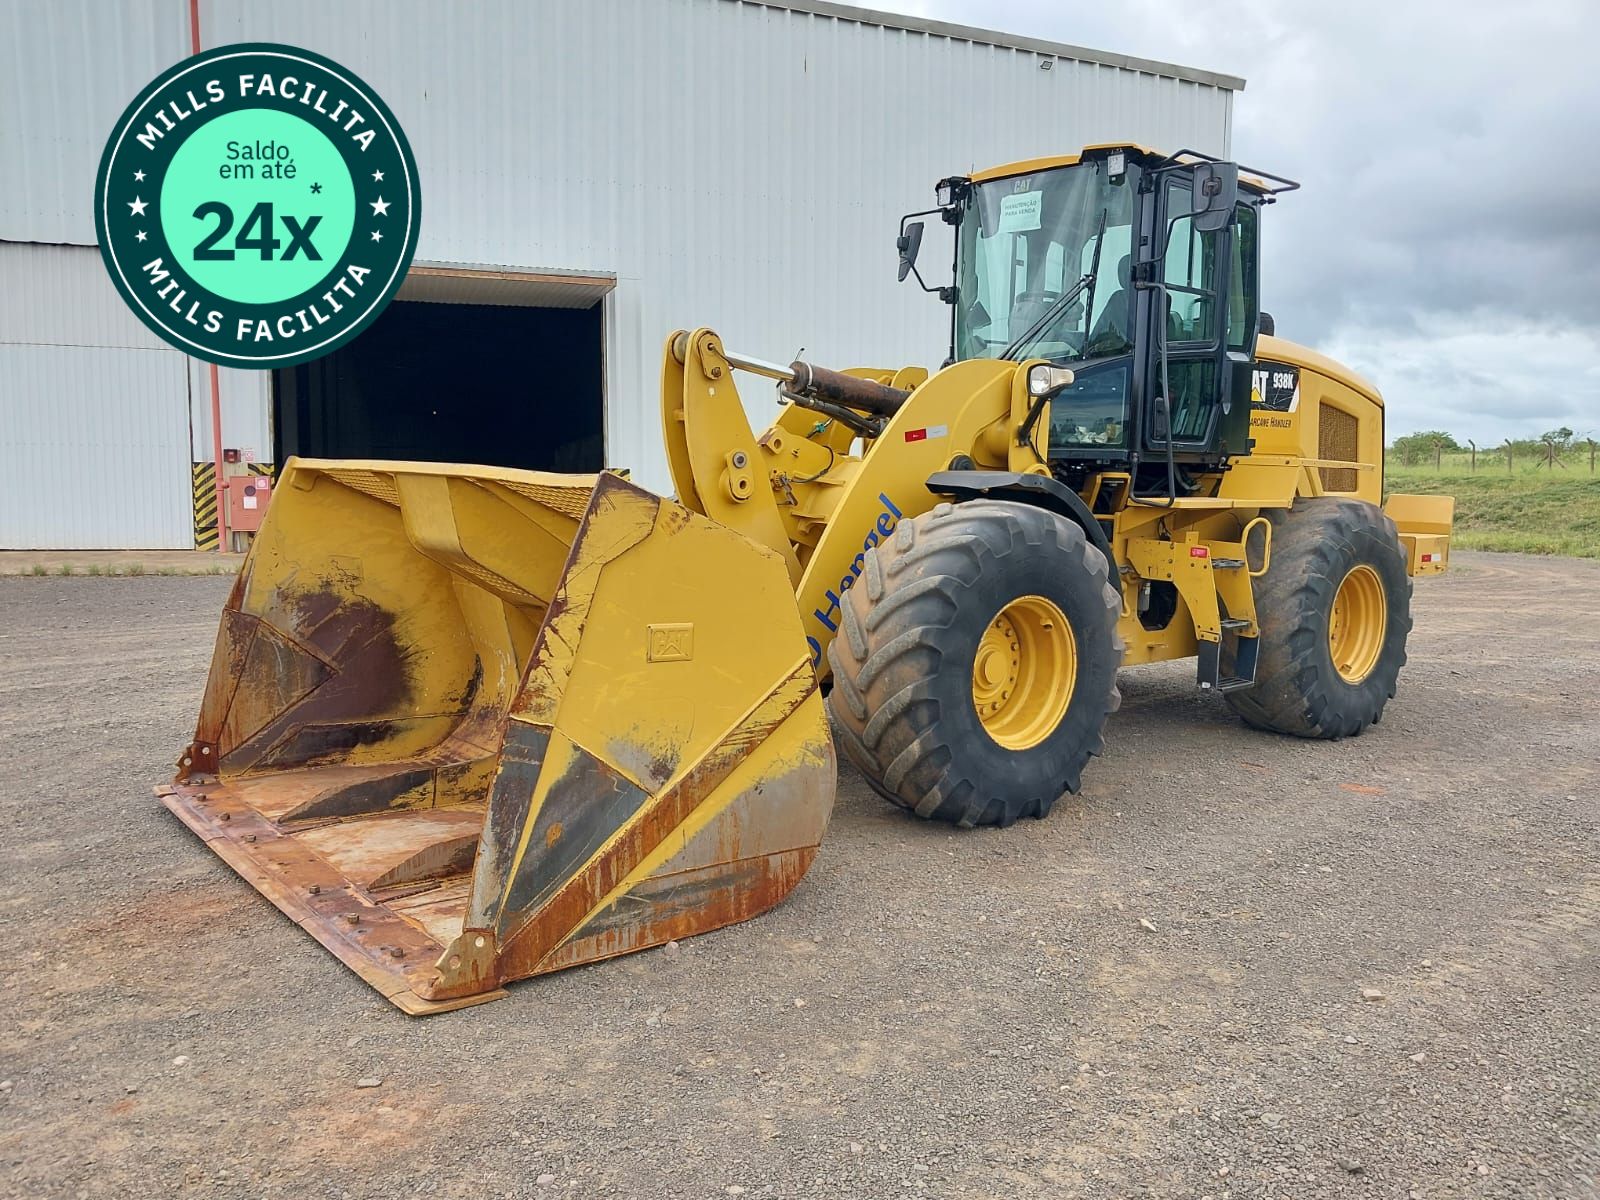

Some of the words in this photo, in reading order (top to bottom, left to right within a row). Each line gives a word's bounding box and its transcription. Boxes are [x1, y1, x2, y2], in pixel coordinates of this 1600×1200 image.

[1014, 178, 1032, 193] CAT
[1251, 370, 1269, 402] AT
[1273, 372, 1294, 389] 938K
[1250, 417, 1270, 427] ARCANE
